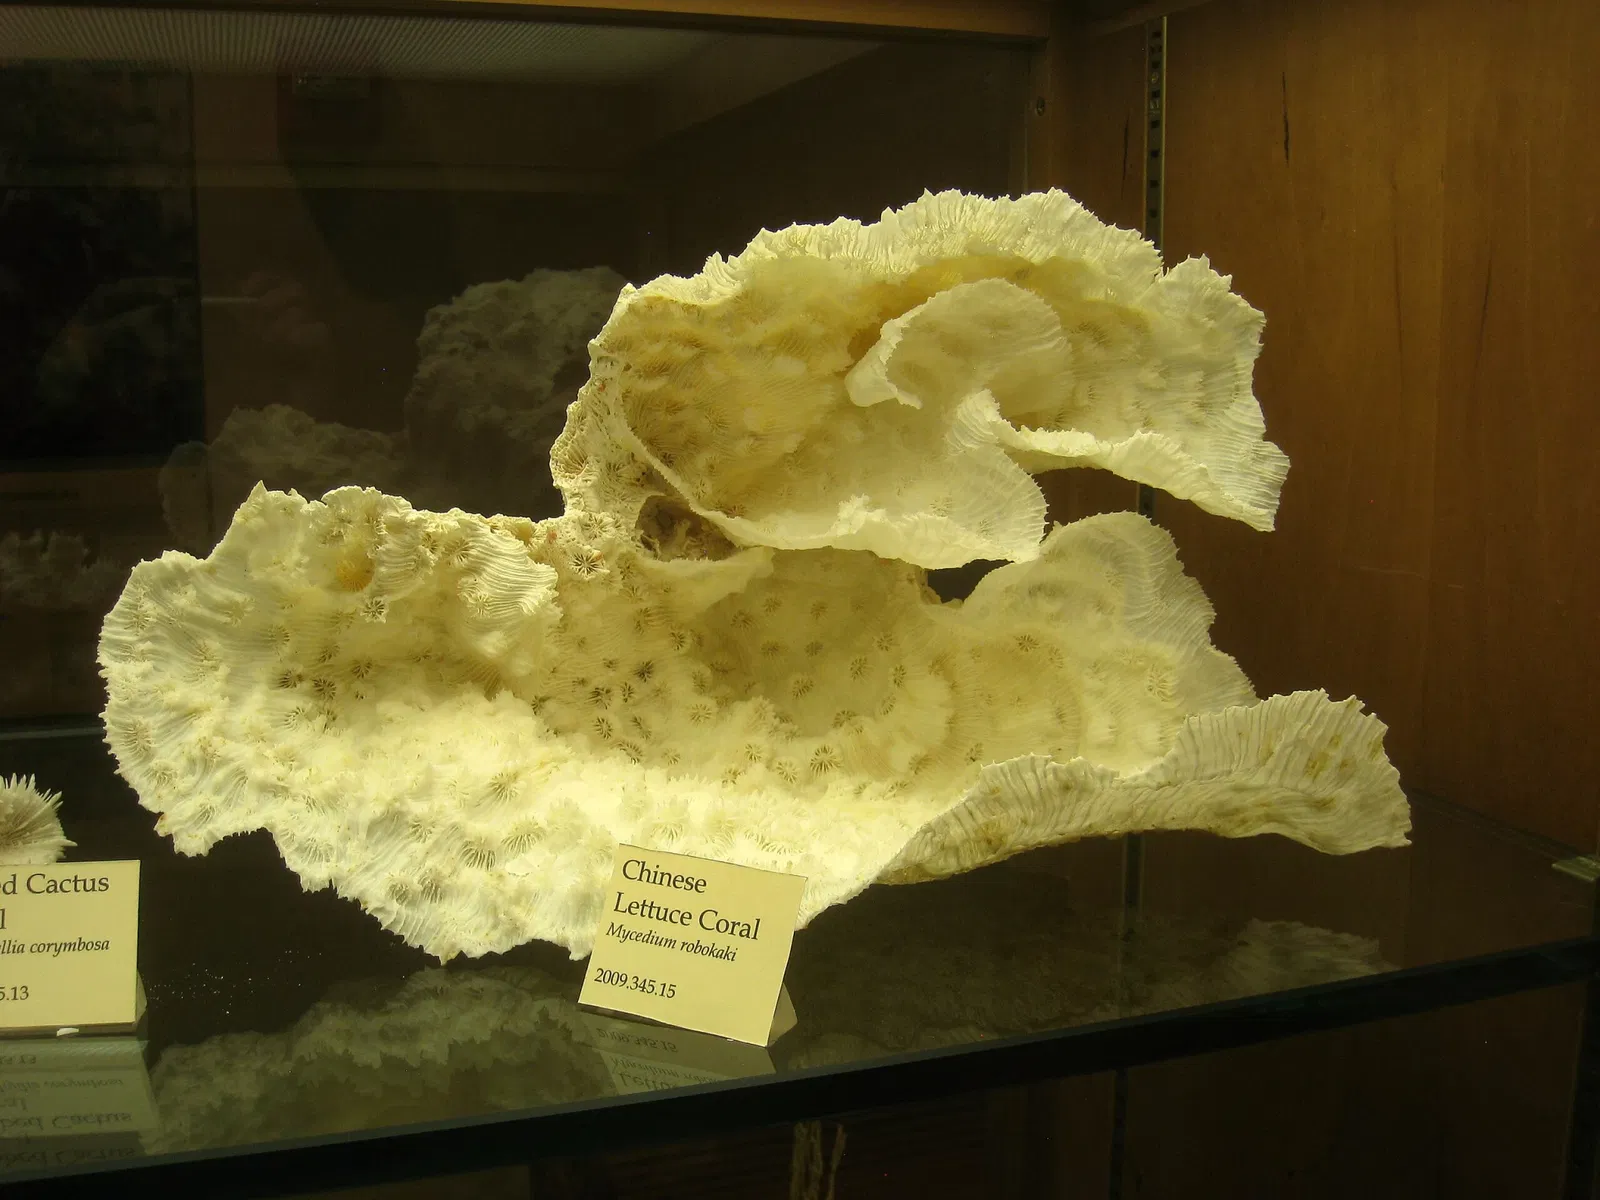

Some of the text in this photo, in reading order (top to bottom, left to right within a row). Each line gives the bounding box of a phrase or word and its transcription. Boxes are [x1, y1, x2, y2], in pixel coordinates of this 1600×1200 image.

[0, 873, 109, 895] d Cactus
[622, 859, 707, 894] Chinese
[613, 892, 761, 940] Lettuce Coral
[0, 938, 110, 957] llia corymbosa
[606, 922, 738, 962] Mycedium robokaki
[594, 968, 677, 999] 2009.345.15
